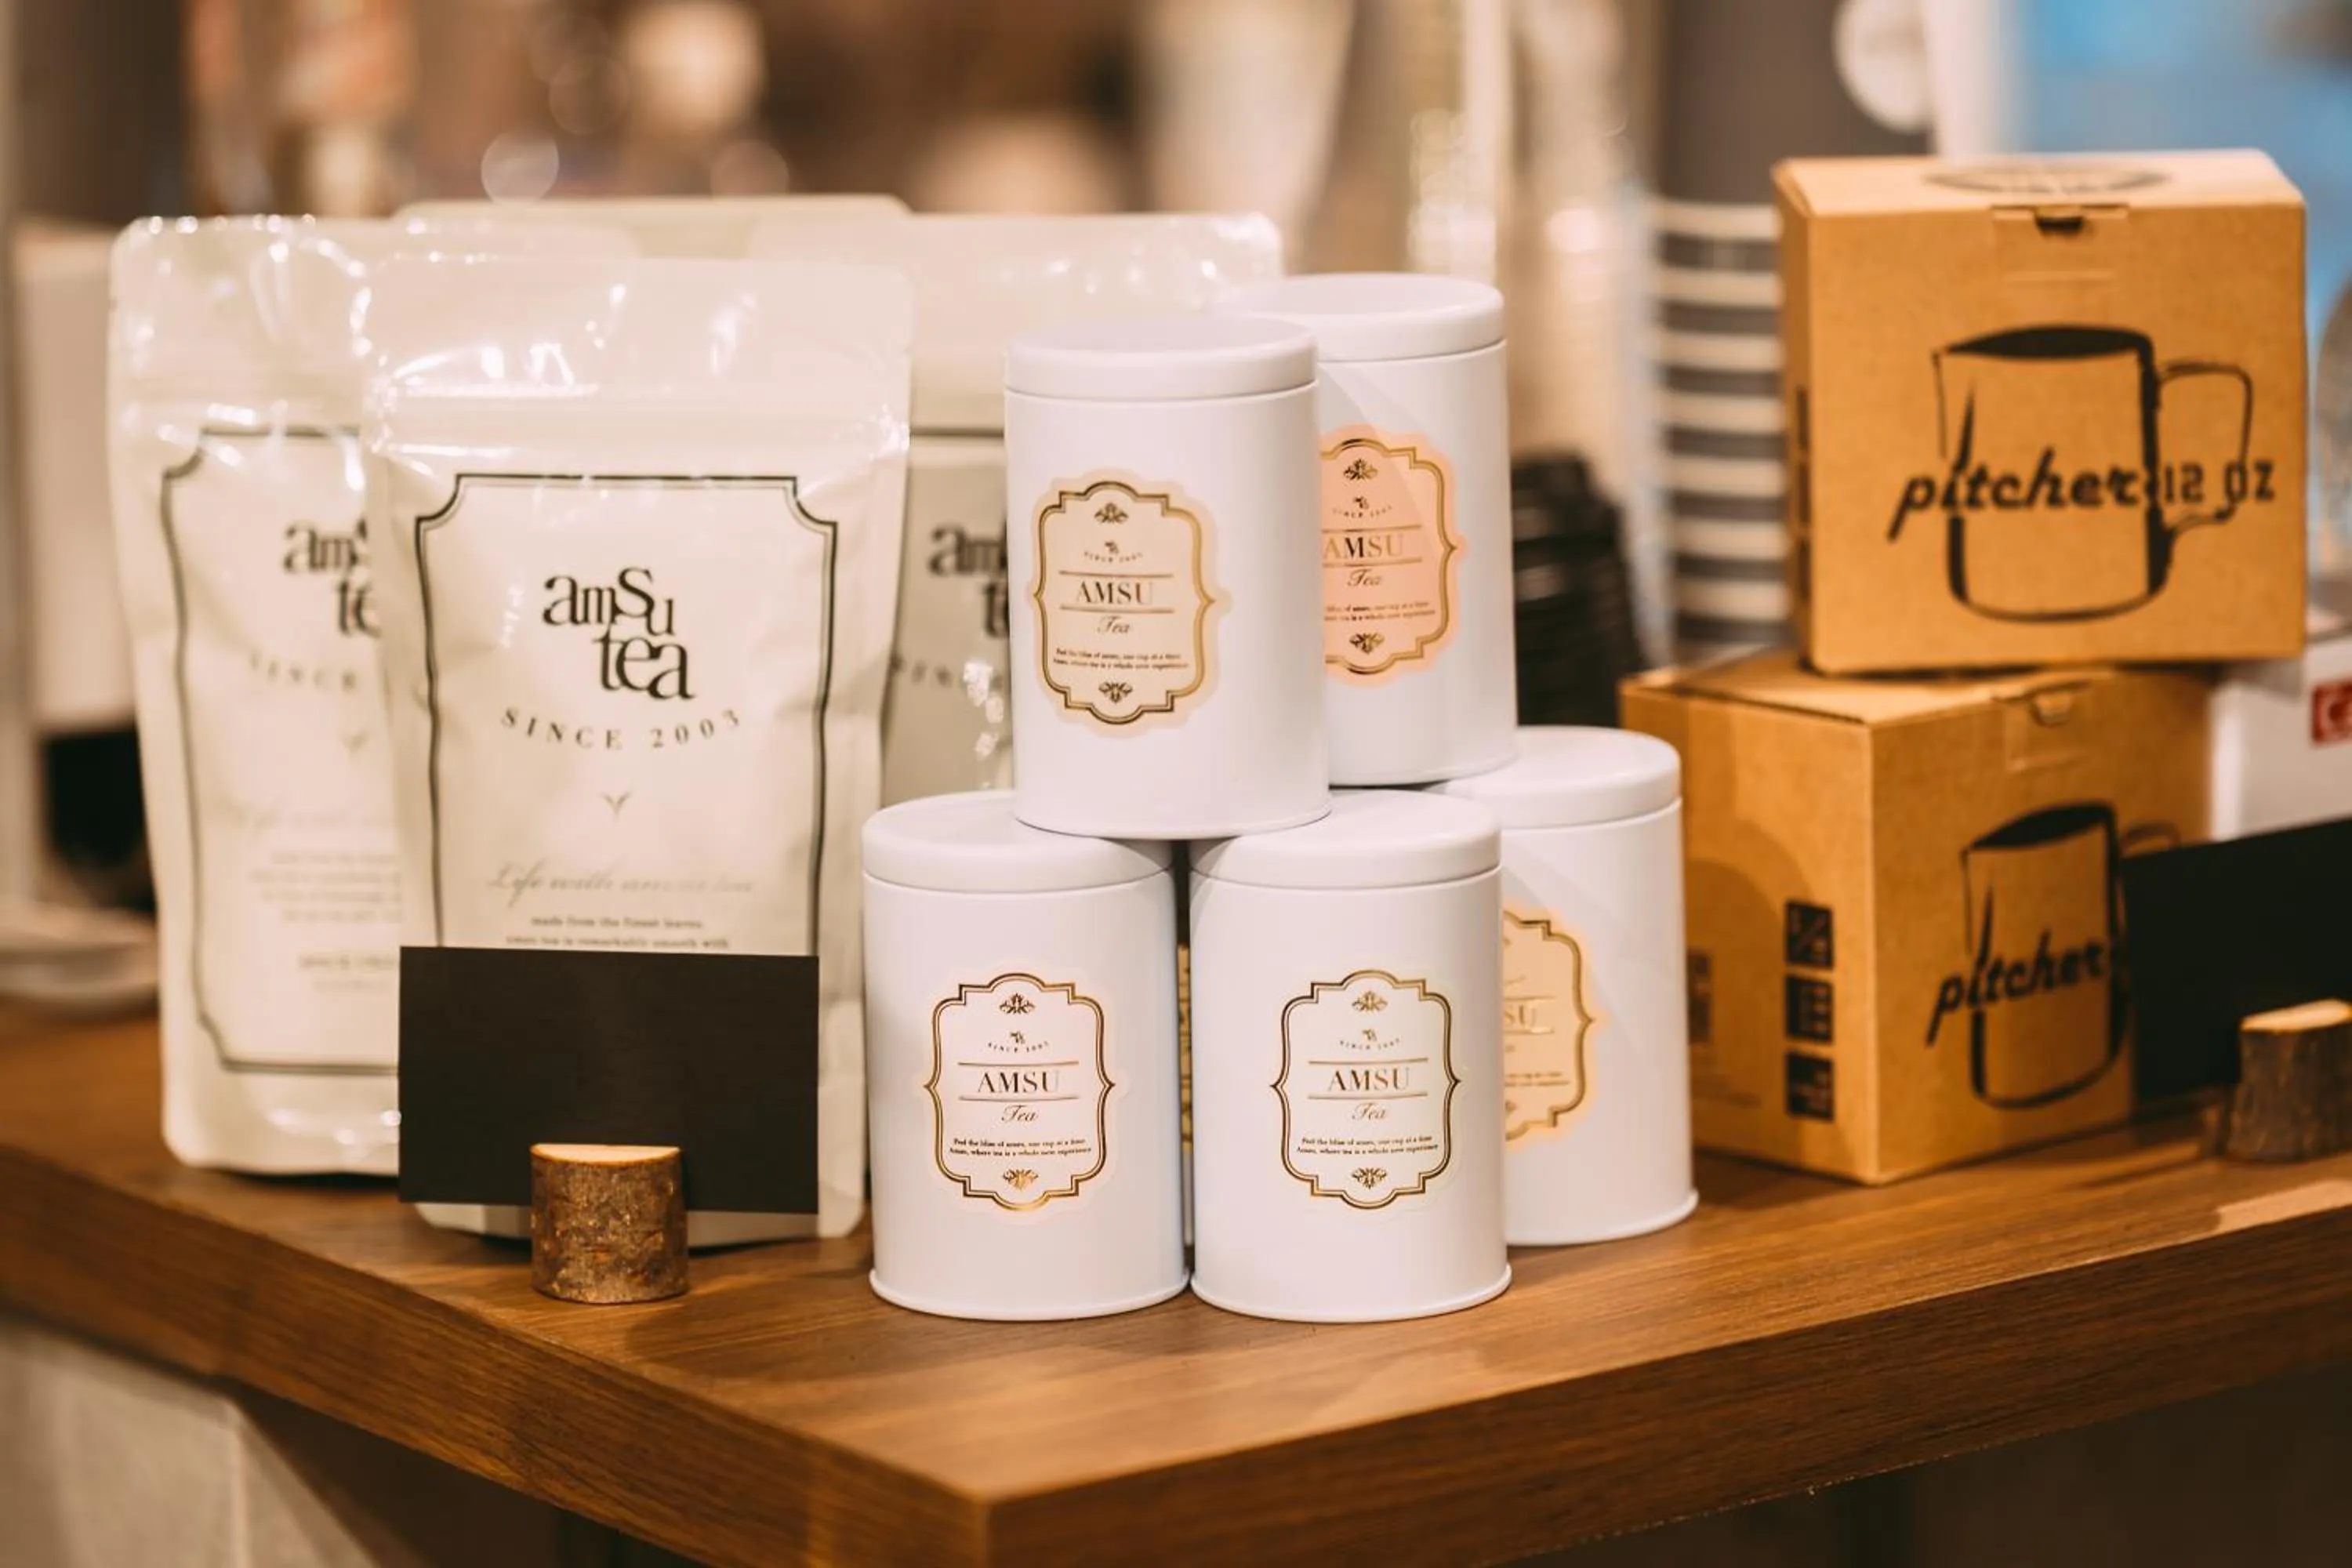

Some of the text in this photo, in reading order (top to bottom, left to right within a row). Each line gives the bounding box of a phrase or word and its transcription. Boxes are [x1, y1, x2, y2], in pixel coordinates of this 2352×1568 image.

[1886, 445, 2140, 543] pitcher
[2163, 461, 2205, 505] 12
[1324, 534, 1404, 560] AMSU
[1346, 568, 1383, 587] Tea
[1076, 580, 1154, 605] AMSU
[1096, 615, 1131, 634] Tea
[591, 624, 697, 700] tea
[501, 707, 624, 750] SINCE
[977, 1071, 1060, 1094] AMSU
[1327, 1067, 1410, 1092] AMSU
[1001, 1105, 1039, 1123] Tea
[1351, 1102, 1387, 1121] Tea
